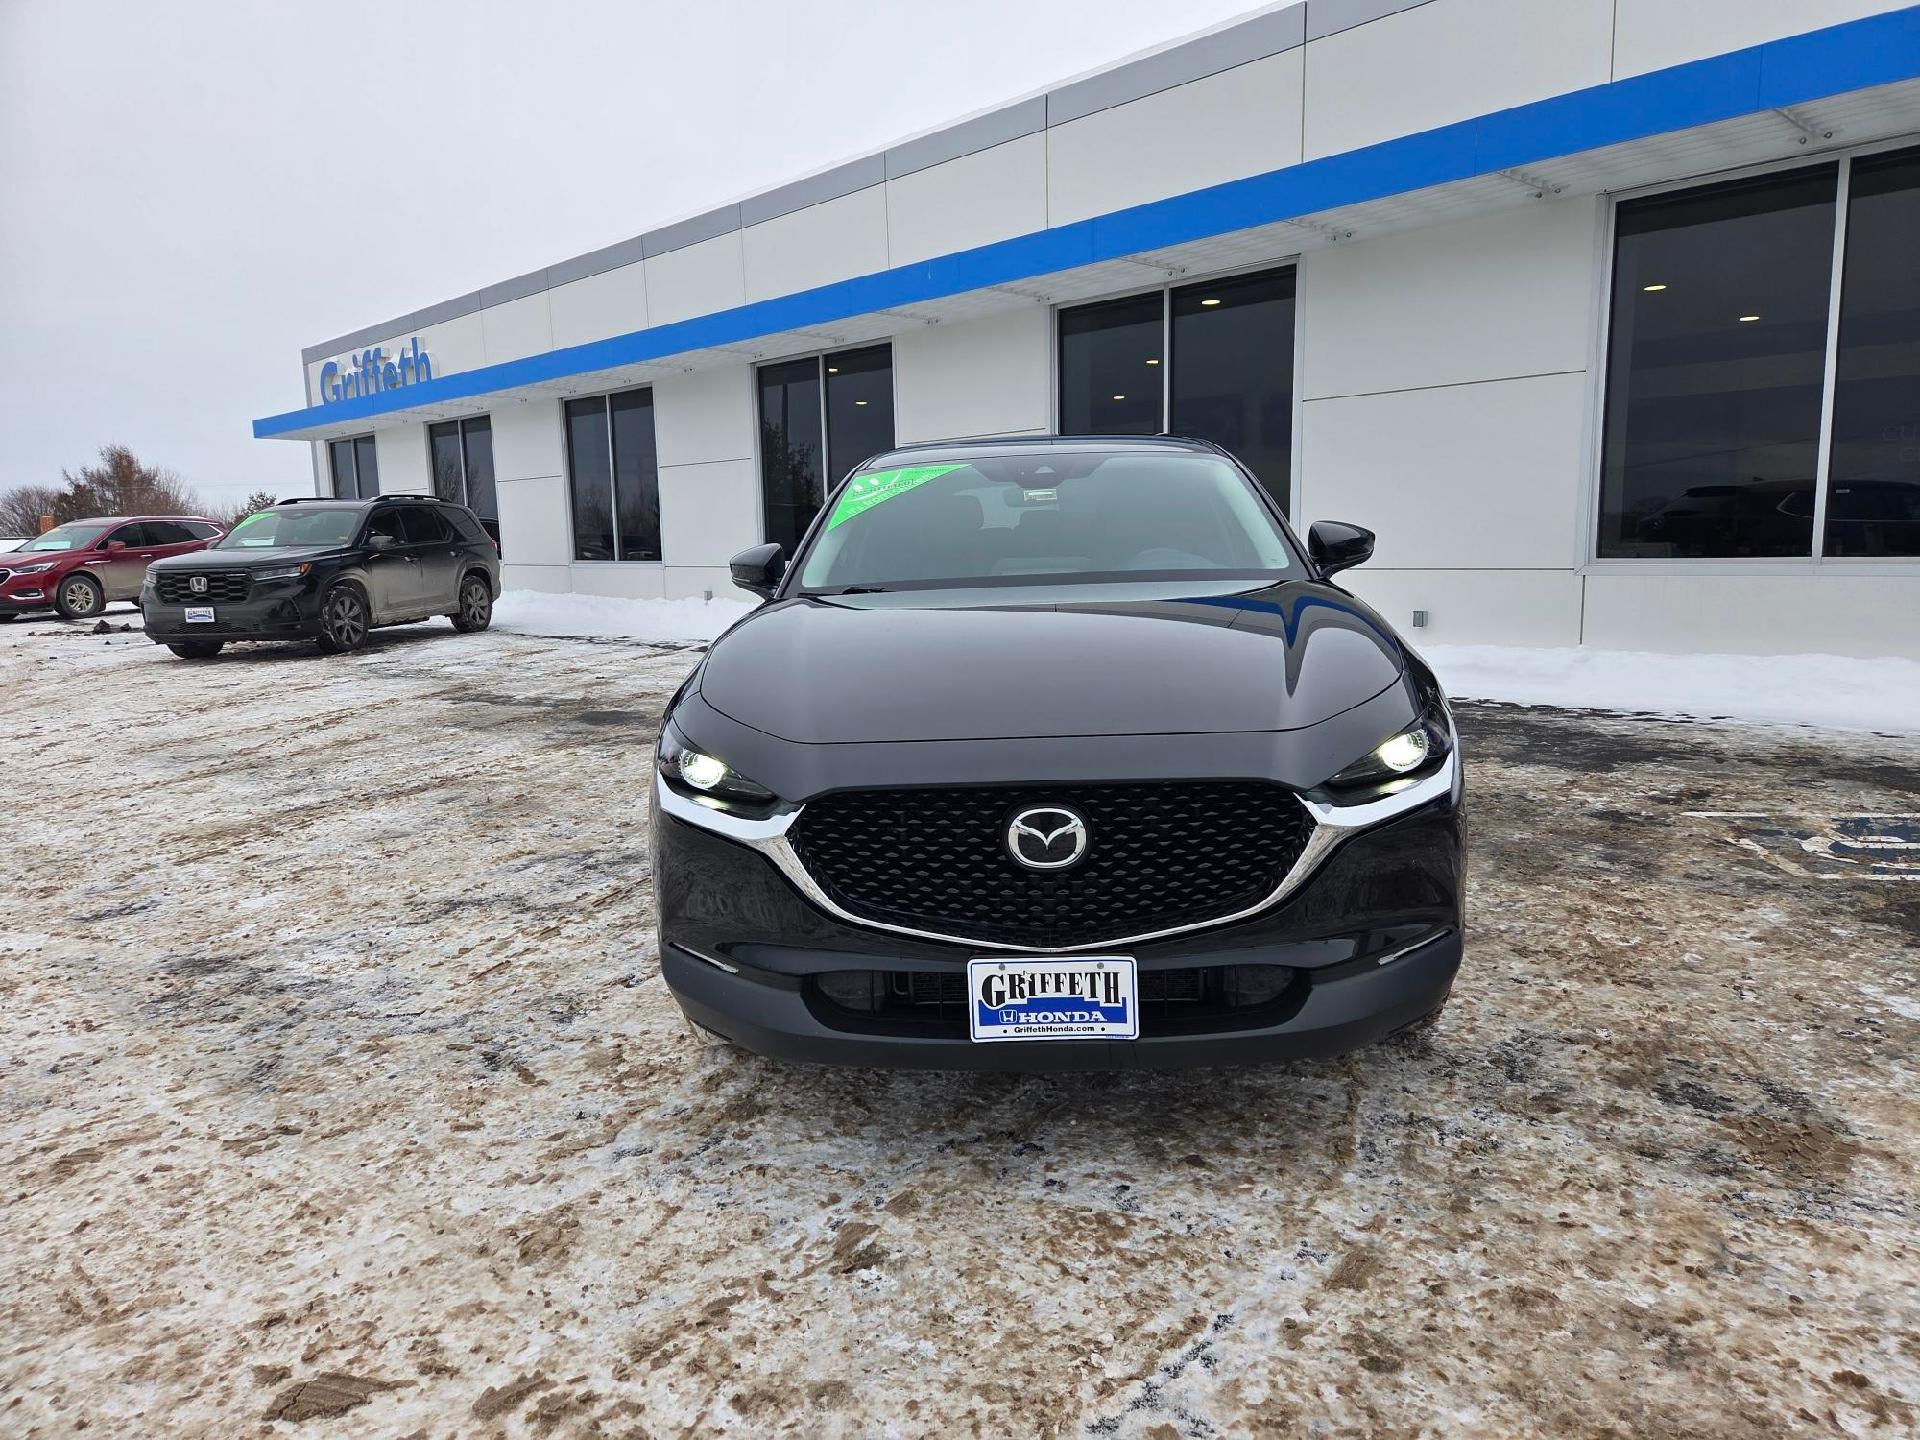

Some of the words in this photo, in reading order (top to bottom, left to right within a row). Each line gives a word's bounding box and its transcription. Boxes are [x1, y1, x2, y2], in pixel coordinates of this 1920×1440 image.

[320, 337, 432, 404] Griffeth
[981, 970, 1121, 1008] GRIFFETH
[1014, 1025, 1095, 1034] GriffethHonda.com
[1018, 1010, 1108, 1024] HONDA
